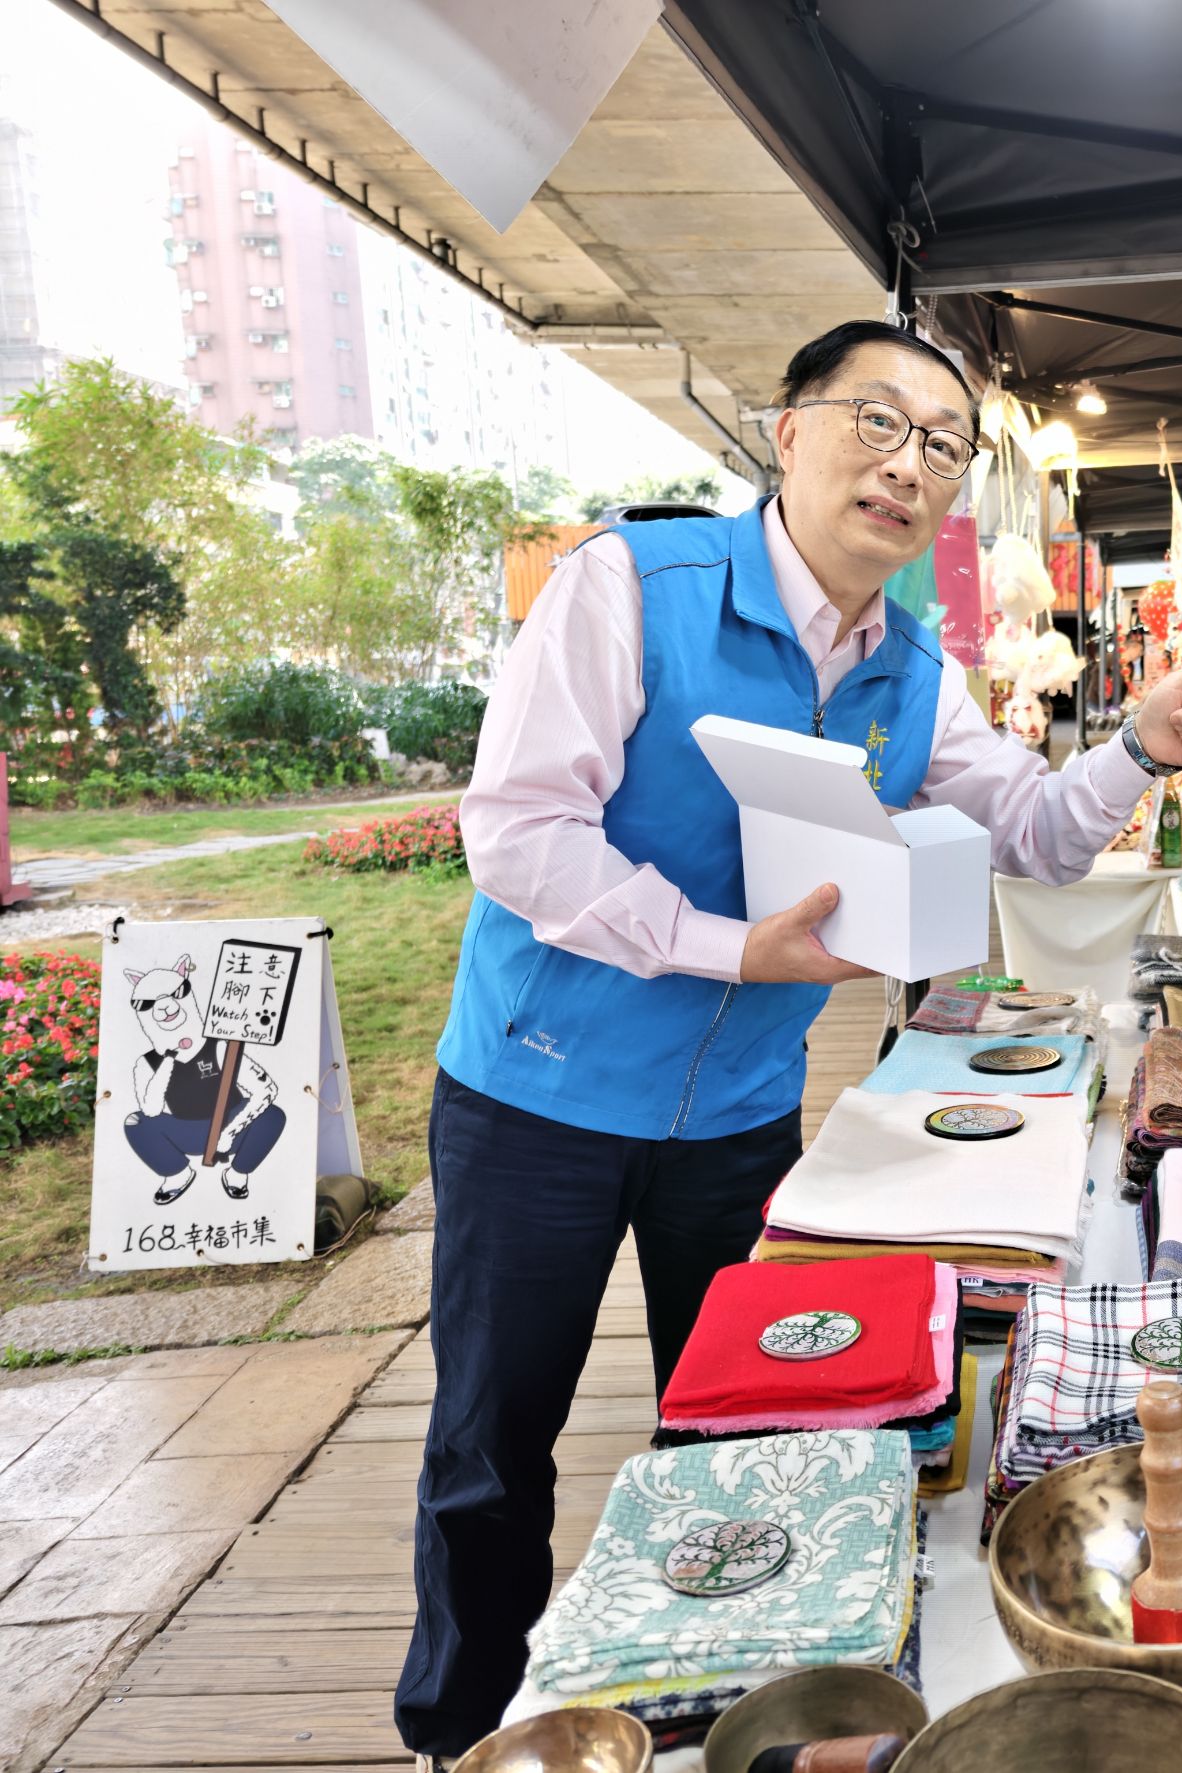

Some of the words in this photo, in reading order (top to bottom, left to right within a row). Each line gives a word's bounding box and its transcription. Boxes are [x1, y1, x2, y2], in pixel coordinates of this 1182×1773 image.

[225, 952, 285, 979] 注意
[221, 980, 277, 1006] 腳下
[212, 1004, 248, 1021] Watch
[211, 1019, 235, 1034] Your
[241, 1023, 273, 1042] Step!
[228, 1082, 273, 1137] TAIWAN
